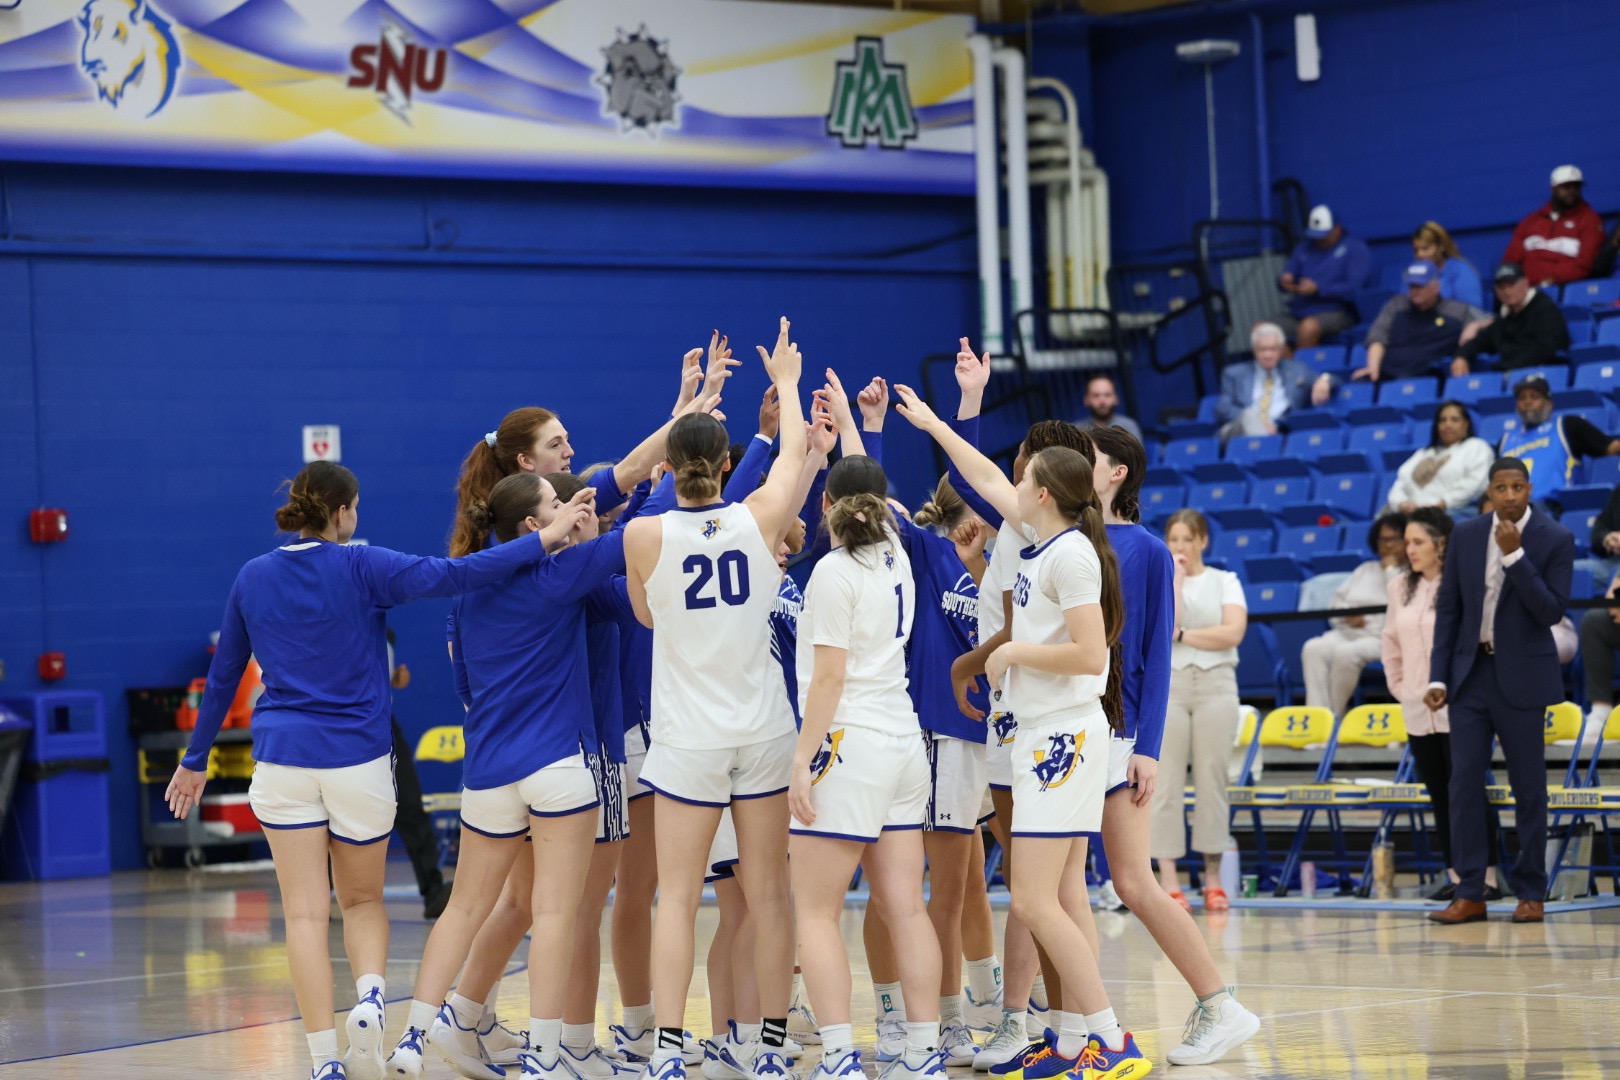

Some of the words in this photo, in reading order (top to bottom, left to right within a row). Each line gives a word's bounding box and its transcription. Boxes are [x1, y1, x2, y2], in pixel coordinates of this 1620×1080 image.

[347, 30, 448, 103] SNU
[682, 549, 750, 611] 20
[894, 582, 904, 639] 1
[1551, 792, 1599, 806] MULERIDERS
